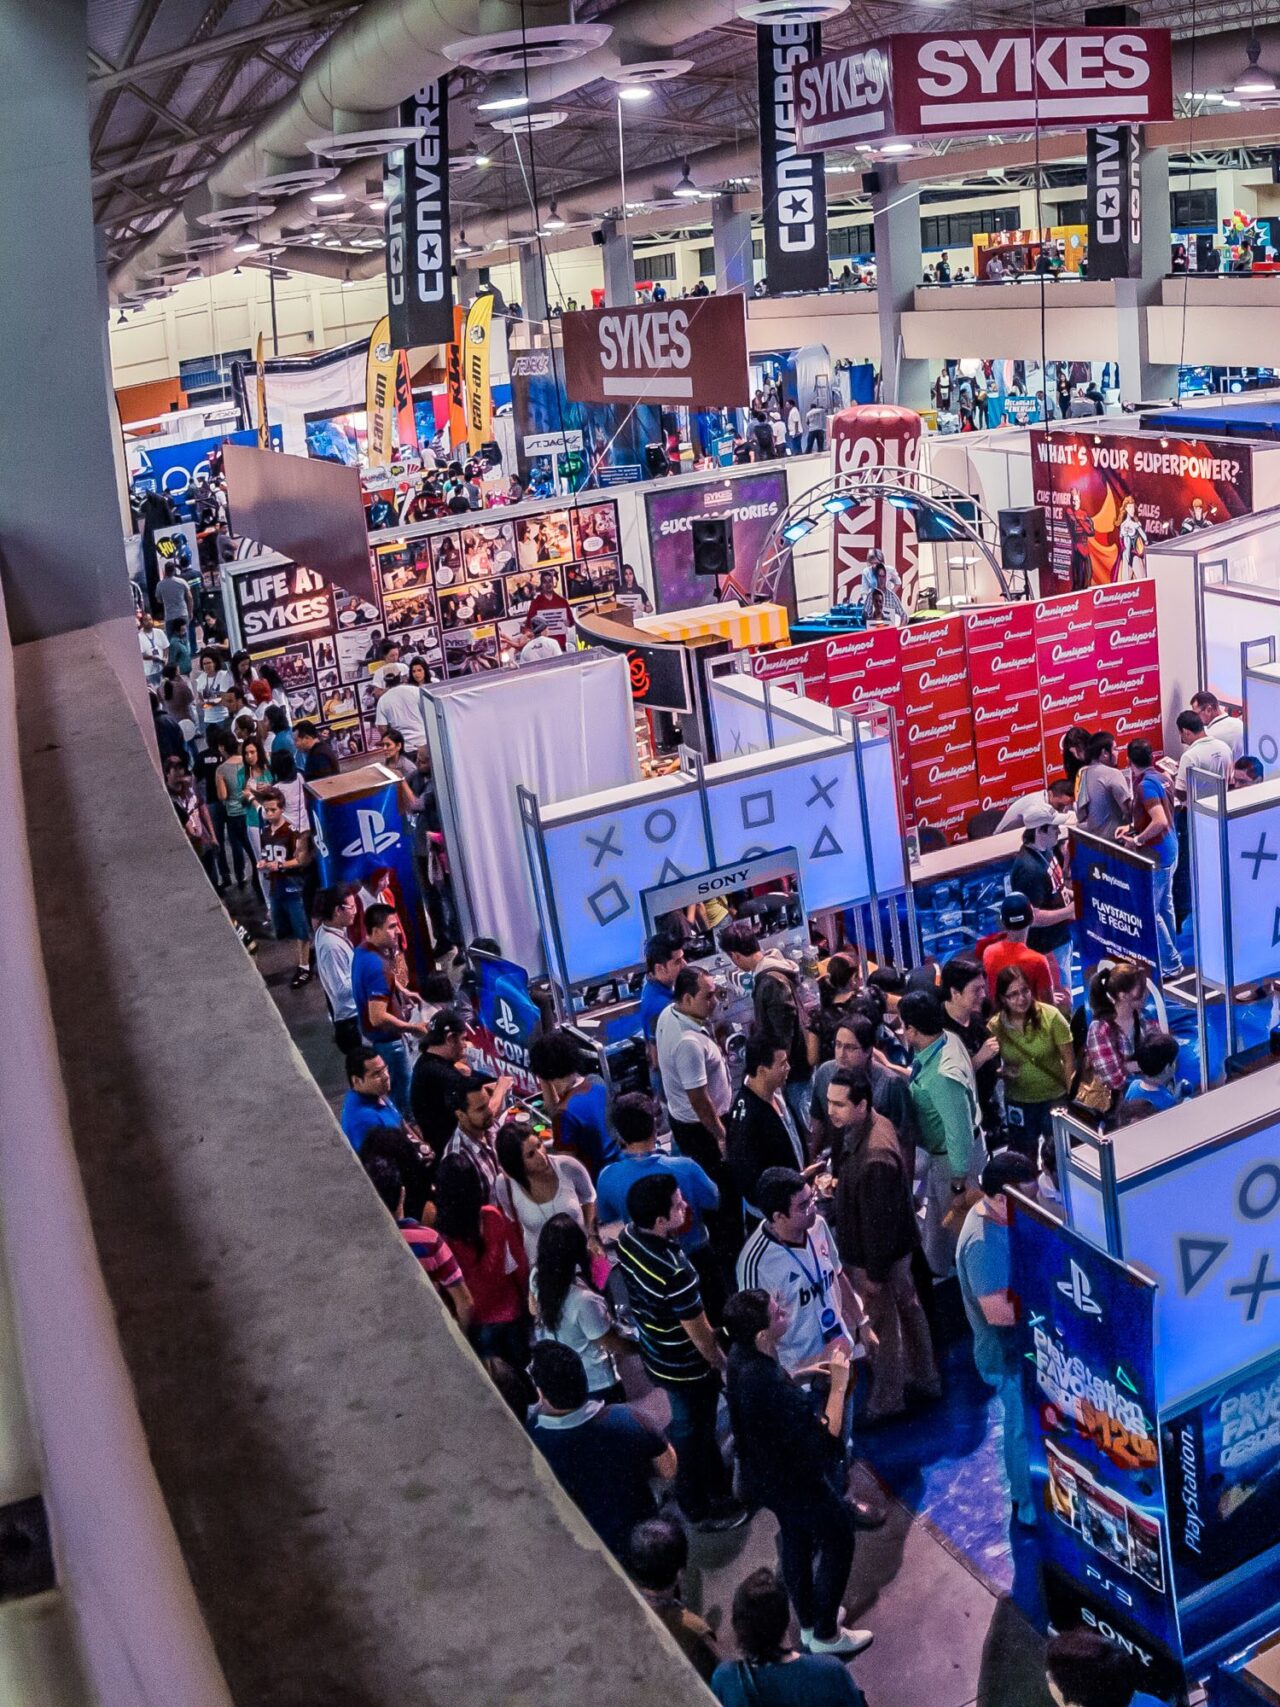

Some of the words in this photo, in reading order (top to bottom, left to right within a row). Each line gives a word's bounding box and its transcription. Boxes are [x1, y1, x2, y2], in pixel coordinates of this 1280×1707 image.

[917, 34, 1150, 97] SYKES
[800, 48, 884, 120] SYKES
[415, 79, 444, 302] CONVERS
[599, 309, 692, 370] SYKES
[472, 354, 482, 431] can-am
[373, 373, 387, 454] can-am
[1037, 443, 1087, 466] WHAT'S
[1092, 448, 1129, 470] YOUR
[1134, 451, 1240, 483] SUPERPOWER?
[1036, 490, 1072, 506] CUSOMER
[1137, 503, 1160, 519] SALES
[239, 571, 289, 606] LIFE
[295, 566, 324, 594] AT
[1093, 587, 1139, 605] Omnisport
[244, 596, 329, 634] SYKES
[968, 611, 1012, 629] Omnisport
[1036, 600, 1079, 619] Omnisport
[900, 624, 948, 646] Omnisport
[1110, 628, 1156, 646] Omnisport
[827, 638, 874, 657] Omnisport
[1052, 641, 1094, 661] Omnisport
[755, 651, 809, 674] Omnisport
[991, 653, 1035, 672] Omnisport
[919, 667, 966, 690] Omnisport
[1099, 674, 1144, 694] Omnisport
[852, 681, 900, 701] Omnisport
[1042, 690, 1084, 710] Omnisport
[975, 702, 1019, 722] Omnisport
[1116, 714, 1161, 732] Omnisport
[909, 719, 957, 741] Omnisport
[998, 742, 1041, 762] Omnisport
[929, 760, 976, 783] Omnisport
[698, 870, 749, 895] SONY
[1092, 897, 1143, 929] PLAYSTATION
[1098, 912, 1108, 925] TE
[1108, 915, 1141, 938] REGALA
[494, 1036, 530, 1068] COPA
[1037, 1348, 1148, 1440] FAVORITOS
[1180, 1430, 1205, 1555] PlayStation
[1085, 1566, 1132, 1607] PS3
[1081, 1607, 1153, 1666] SONY
